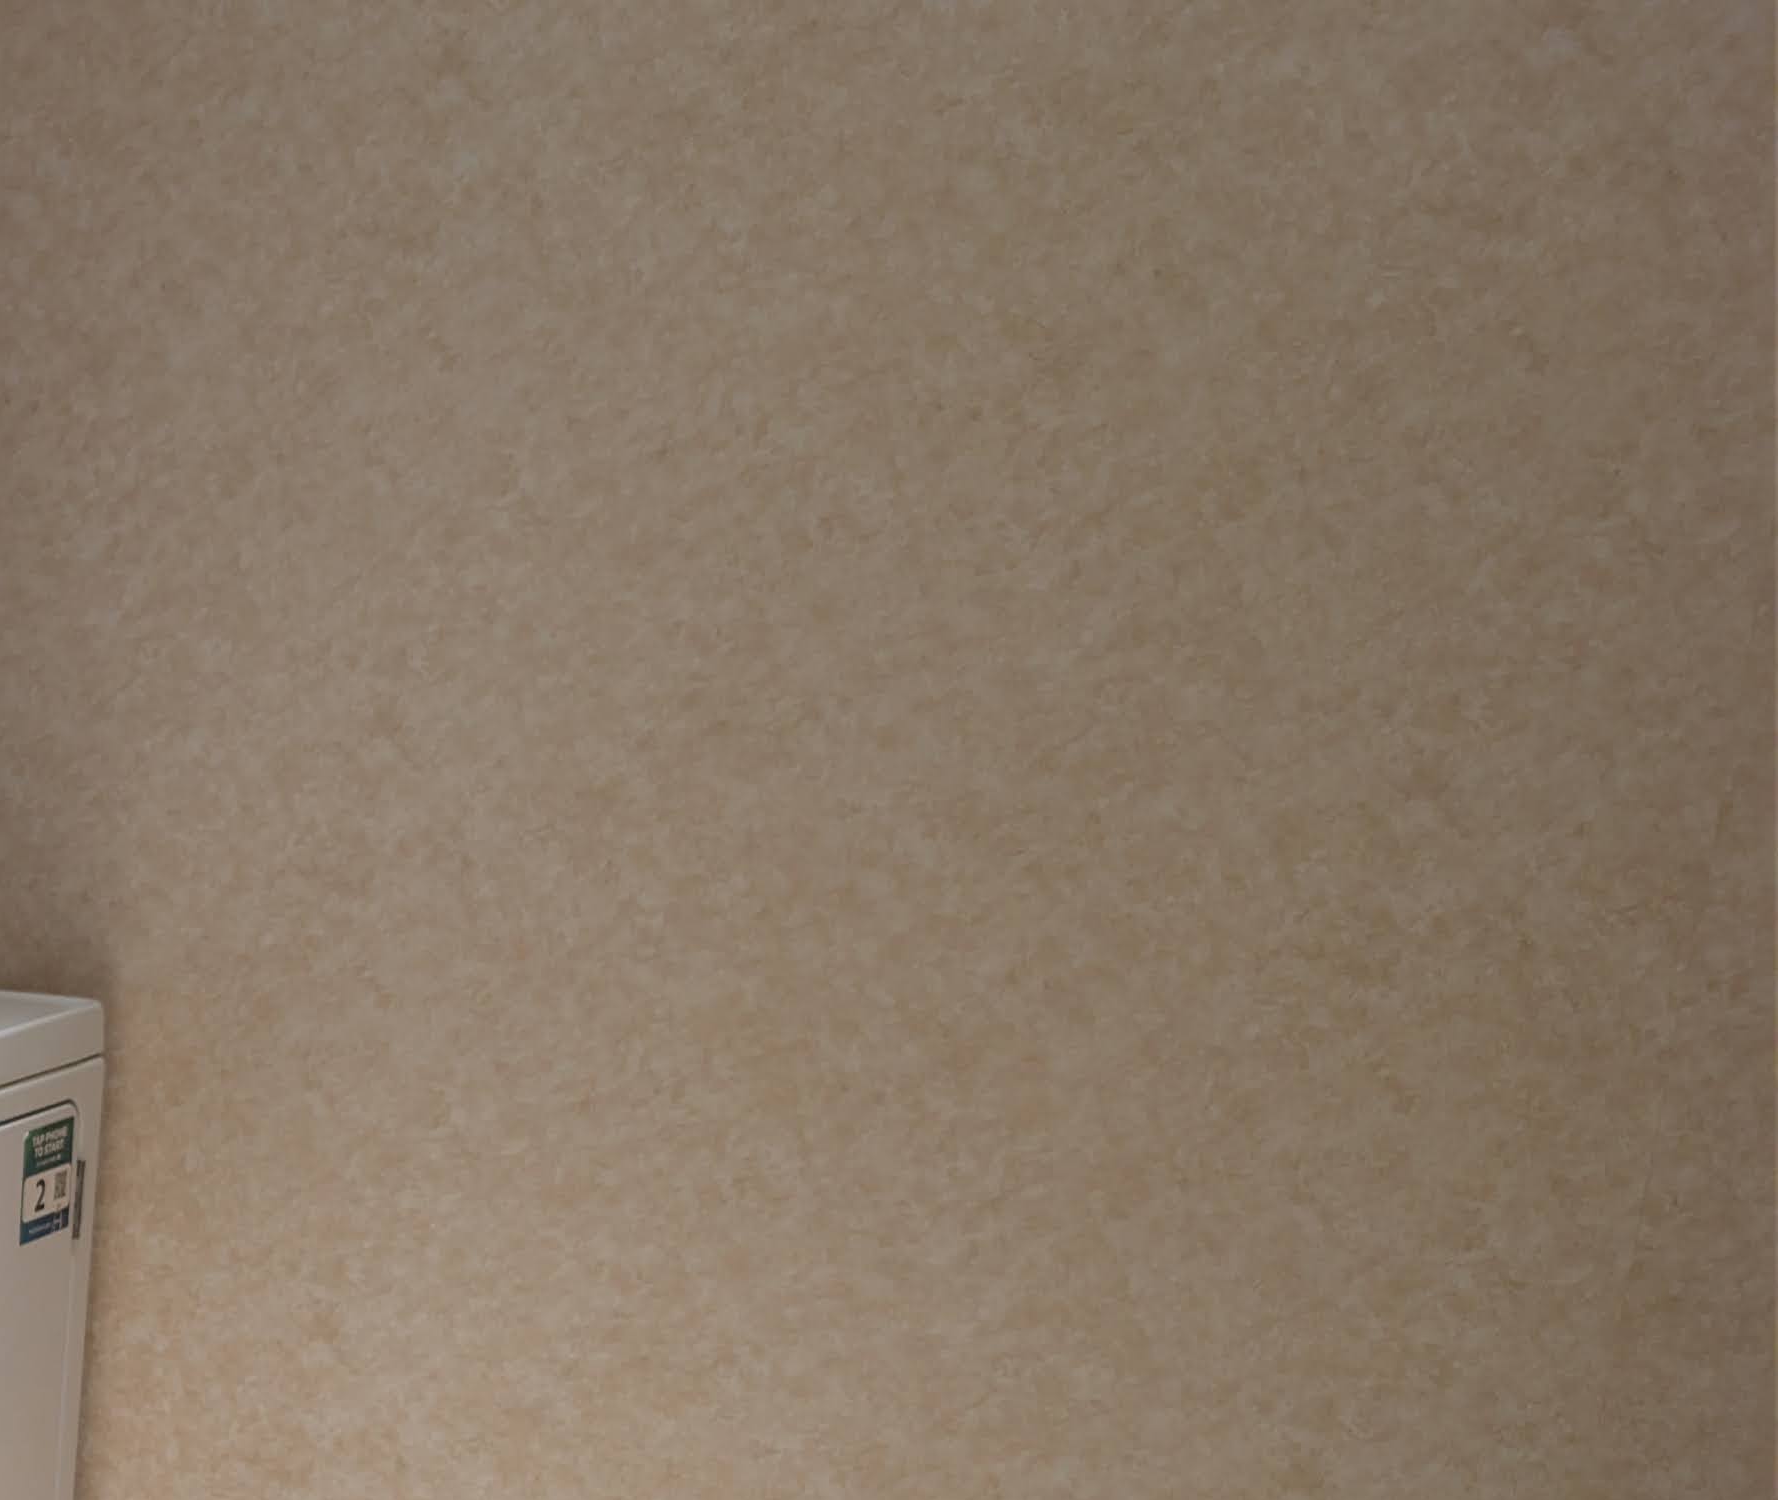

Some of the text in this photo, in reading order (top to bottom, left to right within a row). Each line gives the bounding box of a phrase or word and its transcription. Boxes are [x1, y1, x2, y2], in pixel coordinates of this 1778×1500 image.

[35, 1138, 64, 1158] TO START
[35, 1179, 46, 1213] 2
